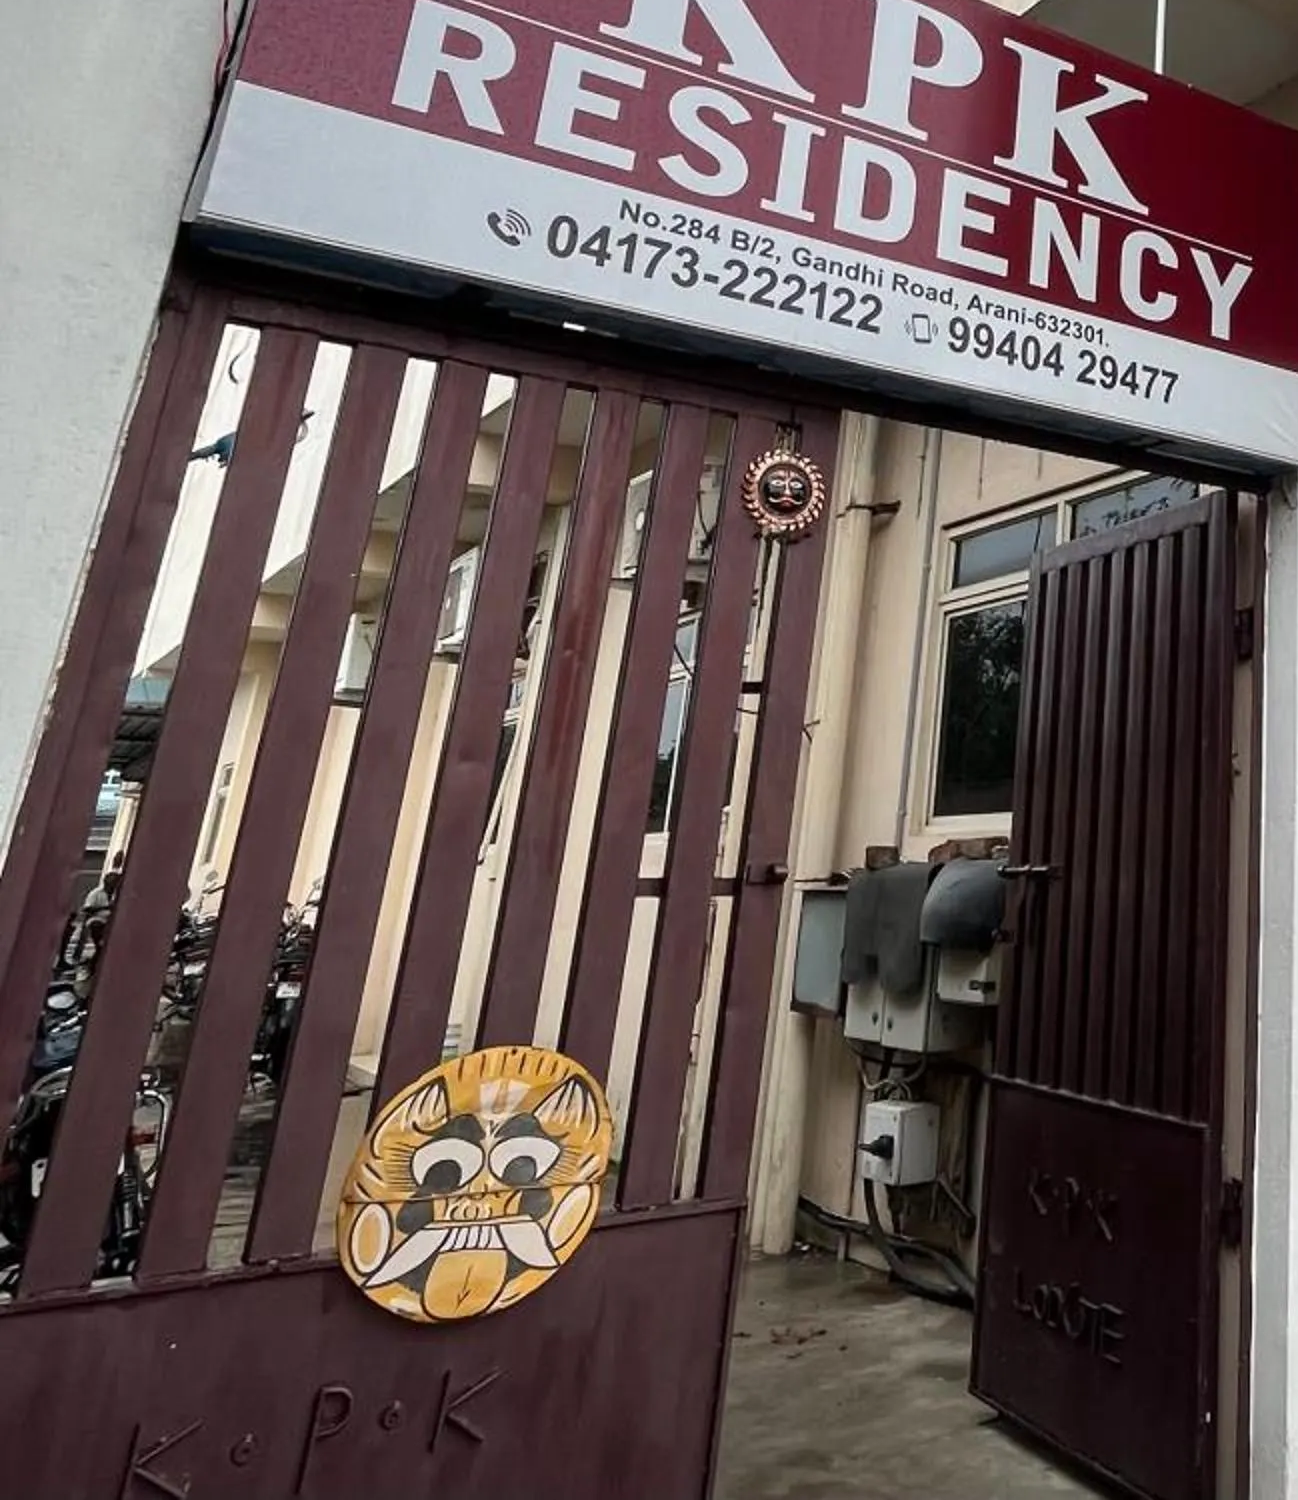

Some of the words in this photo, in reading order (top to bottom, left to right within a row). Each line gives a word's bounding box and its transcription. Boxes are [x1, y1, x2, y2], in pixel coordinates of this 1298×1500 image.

[547, 215, 884, 335] 04173-222122
[948, 316, 1065, 377] 99404
[1076, 349, 1180, 404] 29477
[619, 200, 721, 245] No.284
[731, 229, 782, 264] B/2,
[792, 247, 885, 288] Gandhi
[892, 272, 959, 311] Road,
